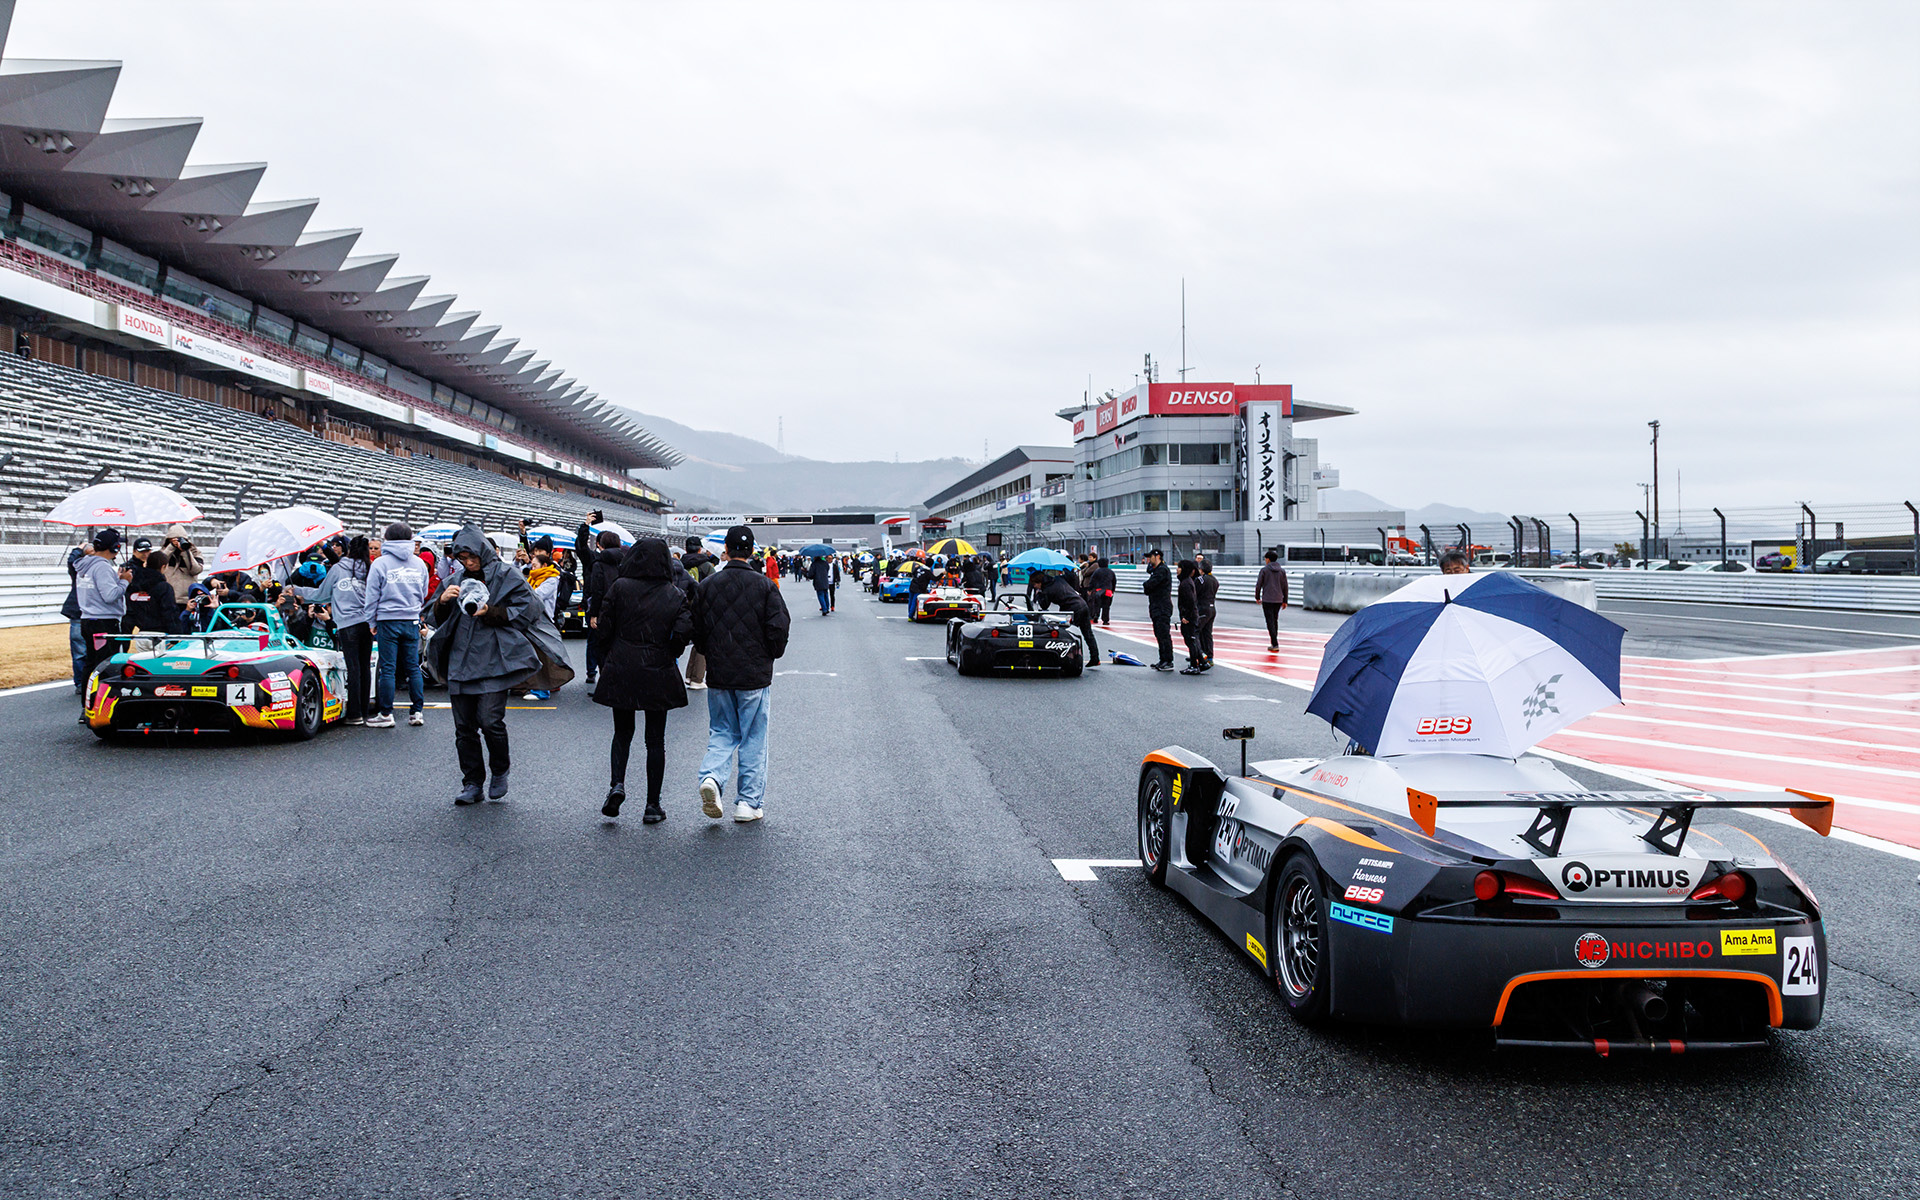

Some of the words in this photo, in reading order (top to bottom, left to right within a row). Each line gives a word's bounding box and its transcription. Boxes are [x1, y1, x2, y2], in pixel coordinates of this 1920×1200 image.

[125, 314, 164, 337] HONDA
[175, 334, 193, 350] HRC
[240, 355, 254, 370] HRC
[308, 376, 331, 393] HONDA
[1121, 394, 1137, 416] DENSO
[1168, 391, 1234, 405] DENSO
[1099, 407, 1113, 427] DENSO
[1019, 626, 1032, 637] 33
[312, 636, 334, 649] 054
[235, 687, 247, 702] 4
[271, 701, 294, 711] MOTUL
[1416, 716, 1472, 735] BBS
[1318, 771, 1349, 788] NICHIBO
[1233, 822, 1273, 874] OPTIMU
[1352, 868, 1387, 884] Harness
[1561, 861, 1691, 893] OPTIMUS
[1344, 885, 1385, 904] BBS
[1724, 934, 1748, 945] Ama
[1750, 933, 1773, 945] Ama
[1612, 941, 1714, 959] NICHIBO
[1786, 945, 1818, 985] 240
